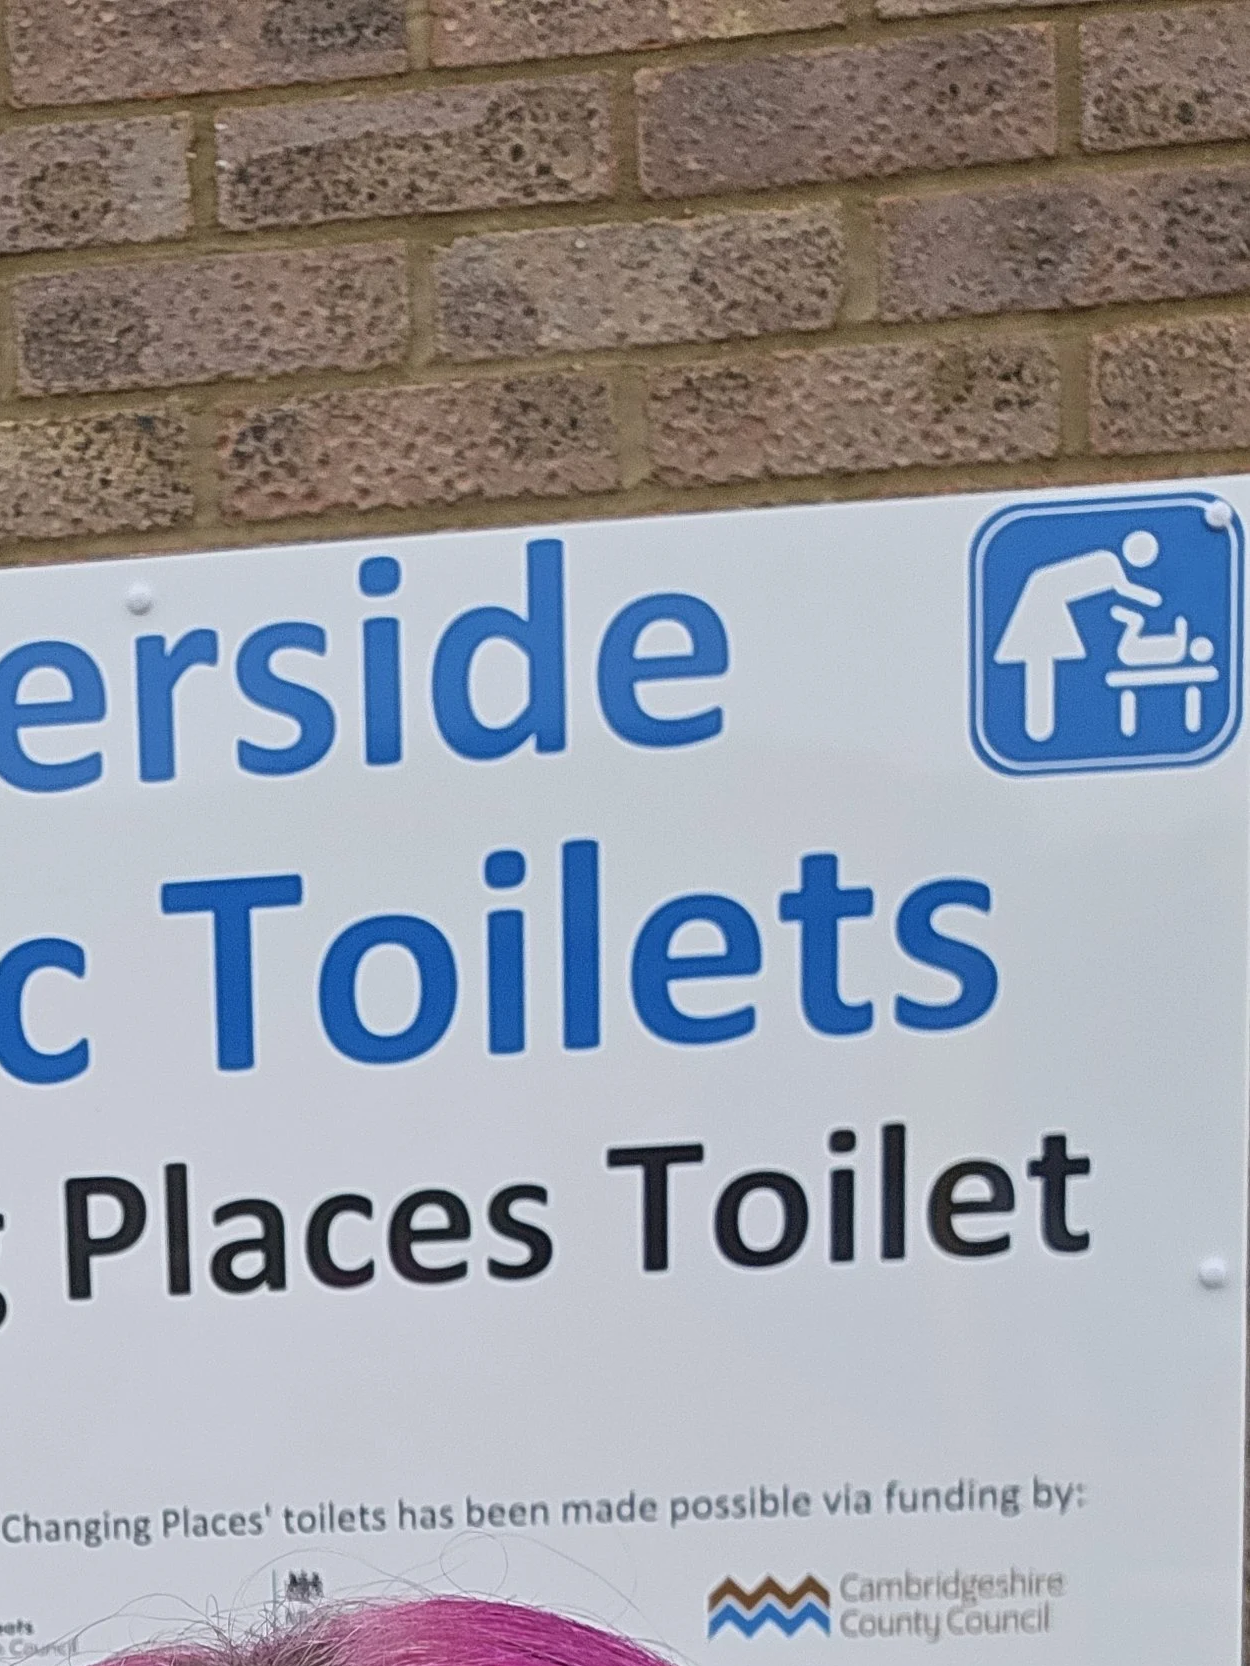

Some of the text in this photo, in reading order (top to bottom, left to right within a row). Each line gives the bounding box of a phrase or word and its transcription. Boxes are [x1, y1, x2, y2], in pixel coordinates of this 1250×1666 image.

[160, 839, 999, 1072] Toilets
[64, 1163, 553, 1300] Places
[607, 1122, 1091, 1272] Toilet
[162, 1503, 272, 1538] Places'
[283, 1500, 387, 1534] toilets
[398, 1498, 454, 1530] has
[465, 1495, 550, 1528] been
[562, 1490, 658, 1525] made
[670, 1484, 812, 1528] possible
[822, 1482, 872, 1515] via
[885, 1478, 1021, 1518] funding
[1032, 1474, 1086, 1515] by:
[839, 1566, 1066, 1608] Cambridgeshire
[839, 1600, 1051, 1644] County Council
